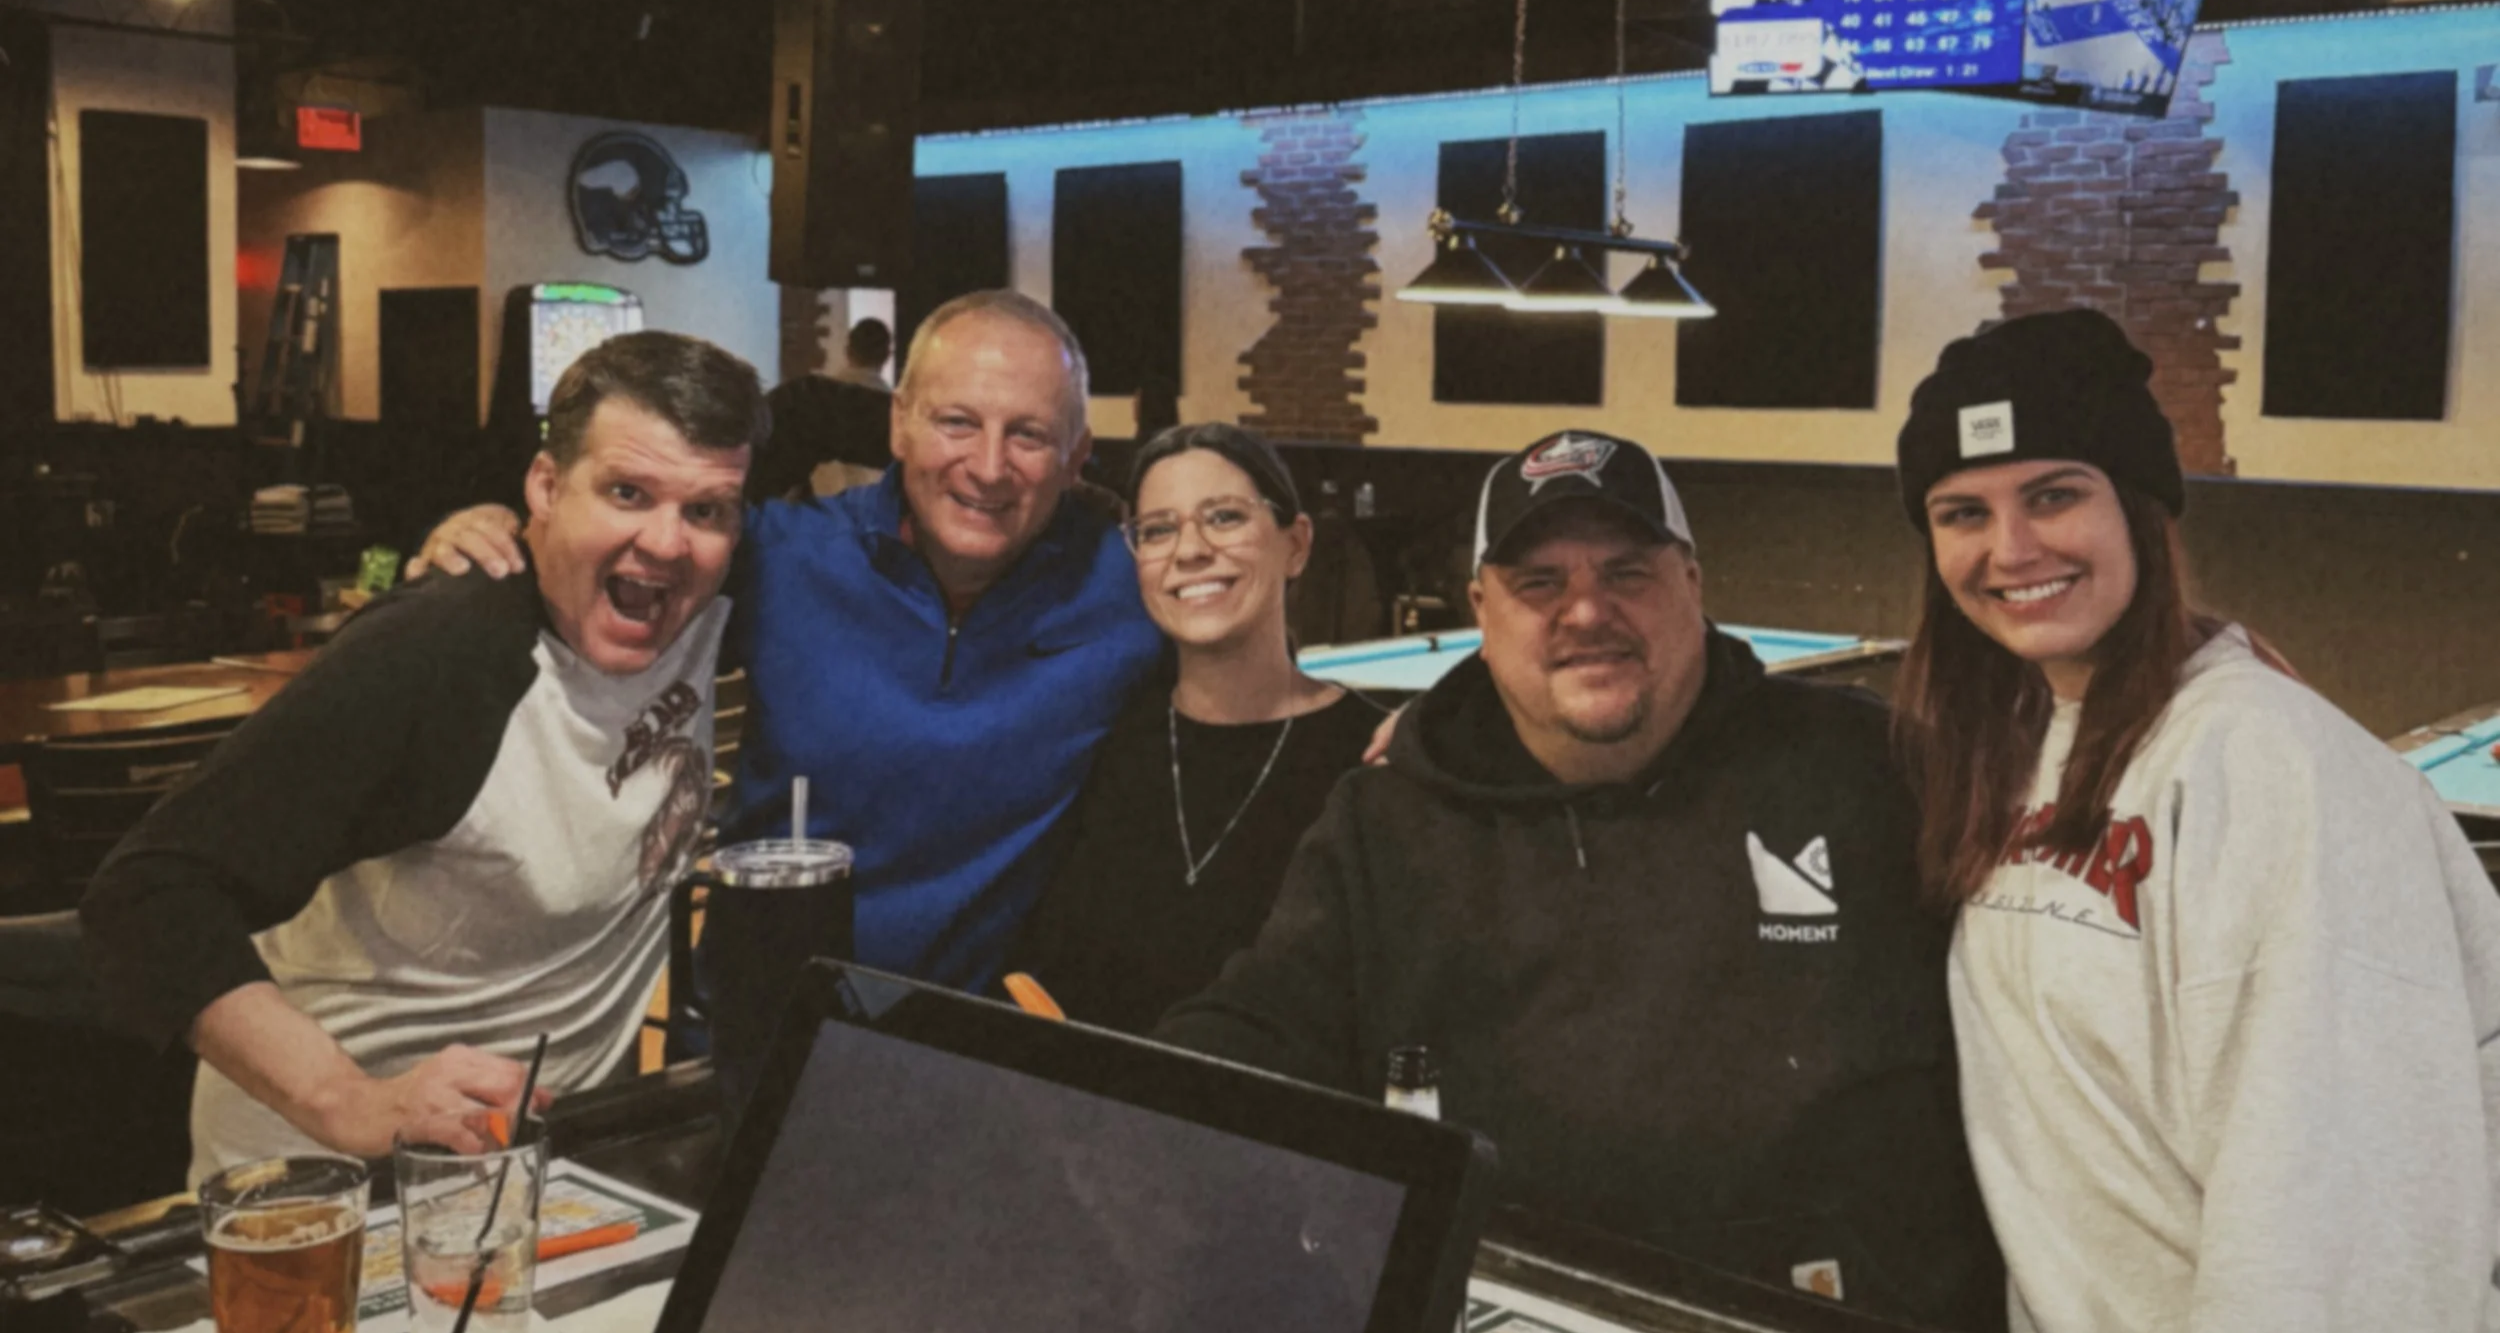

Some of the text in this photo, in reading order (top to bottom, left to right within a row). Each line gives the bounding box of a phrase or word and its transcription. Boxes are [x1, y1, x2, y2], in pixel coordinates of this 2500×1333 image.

[1840, 12, 1862, 29] 40
[1873, 12, 1893, 28] 41
[1758, 923, 1839, 942] MOMENT
